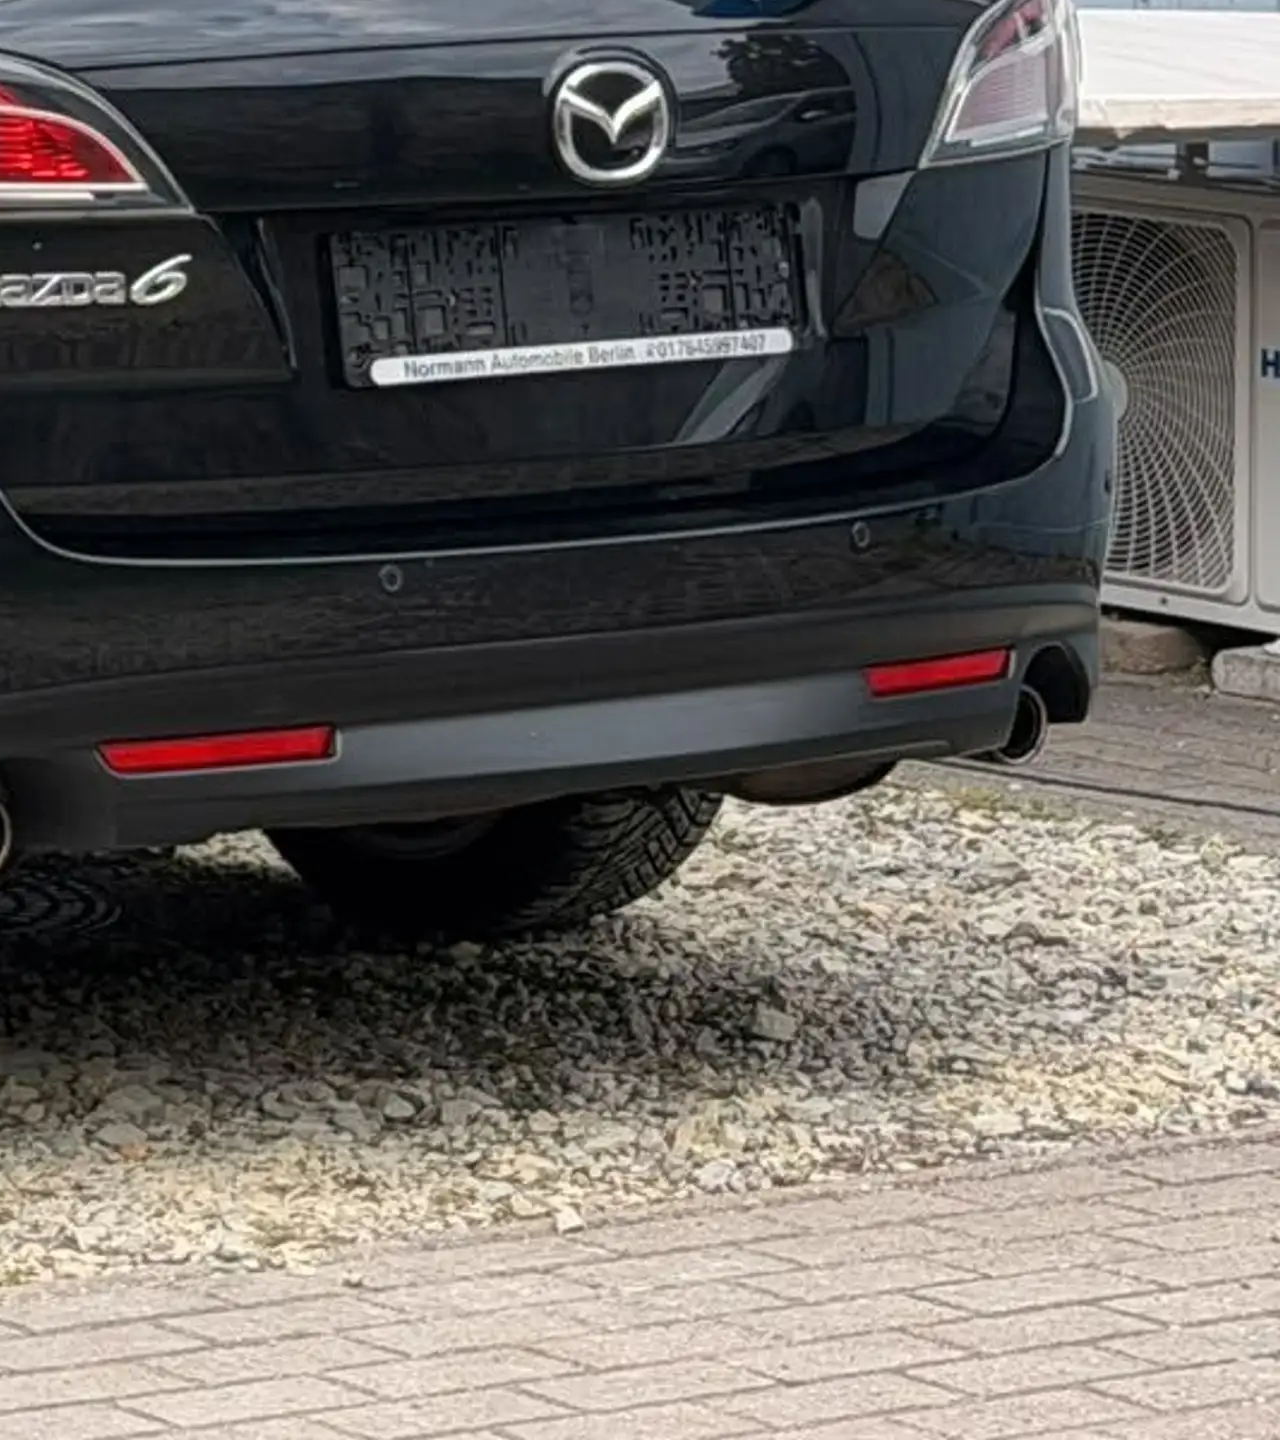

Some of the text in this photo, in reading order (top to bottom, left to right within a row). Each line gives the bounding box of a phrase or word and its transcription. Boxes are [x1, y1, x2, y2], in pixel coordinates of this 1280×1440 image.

[403, 359, 486, 379] Normann
[491, 349, 585, 371] Automobile
[589, 344, 636, 365] Berlin
